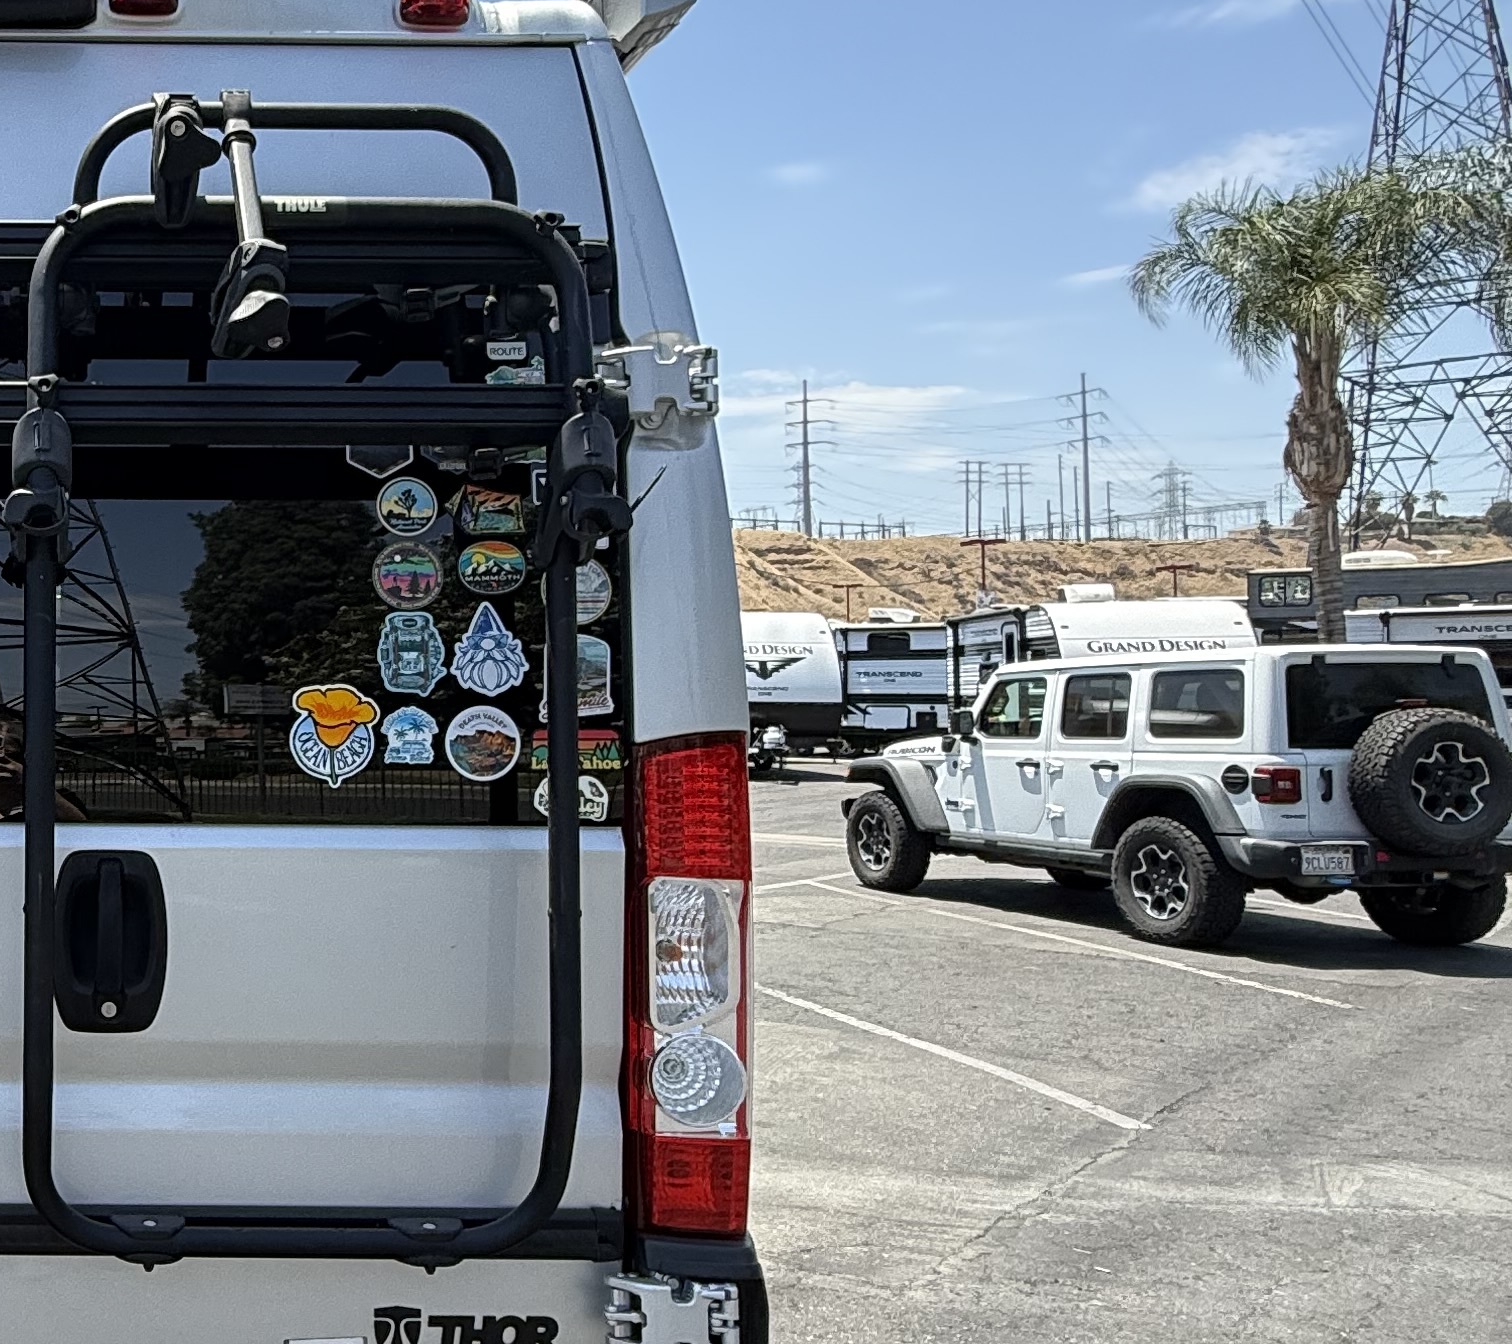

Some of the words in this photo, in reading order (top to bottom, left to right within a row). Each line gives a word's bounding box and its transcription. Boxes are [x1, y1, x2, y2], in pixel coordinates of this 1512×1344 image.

[273, 198, 327, 213] THULE
[489, 347, 524, 356] ROUTE
[464, 573, 520, 582] MAMMOTH
[762, 645, 813, 655] DESIGN
[1087, 640, 1155, 653] GRAND
[1158, 639, 1226, 652] DESIGN
[458, 713, 481, 729] DEATH
[482, 713, 508, 729] VALLEY
[298, 731, 329, 770] OCEAN
[335, 735, 368, 770] BEACH
